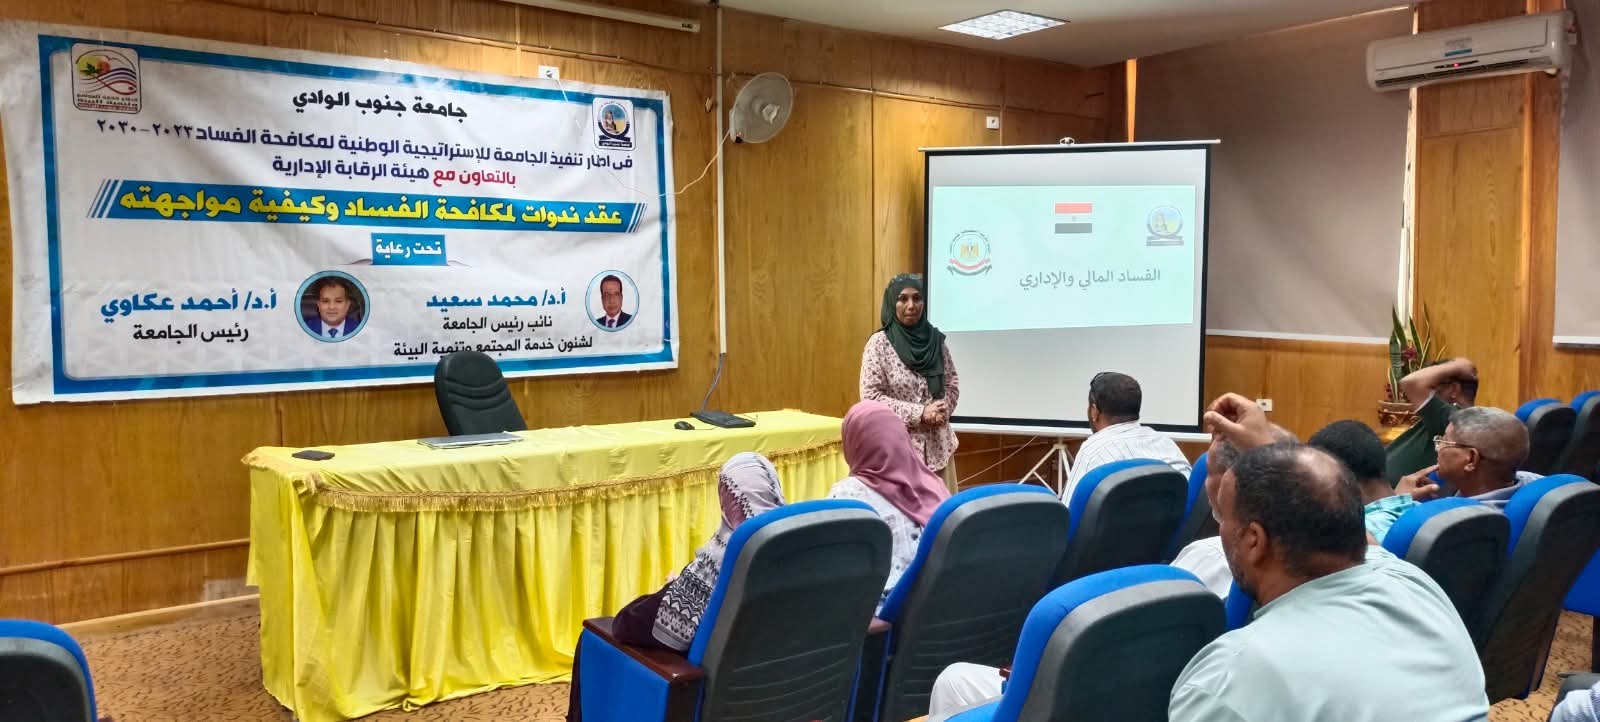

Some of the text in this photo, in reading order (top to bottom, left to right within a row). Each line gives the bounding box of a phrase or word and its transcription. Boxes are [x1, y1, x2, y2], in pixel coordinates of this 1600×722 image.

[293, 90, 467, 123] جامعة جنوب الوادي
[196, 126, 256, 144] الفساد
[260, 129, 334, 149] لمكافحة
[338, 135, 399, 156] الوطنية
[494, 148, 547, 166] الجامعة
[550, 152, 583, 168] تنفيذ
[273, 156, 515, 188] بالتعاون مع هيئة الرقابة الإدارية
[119, 184, 623, 228] عقد ندوات لمكافحة الفساد وكيفية مواجهته
[376, 239, 442, 258] تحت رعاية
[1019, 268, 1160, 291] الفساد المالي والإداري
[101, 292, 175, 323] عكاوي
[181, 288, 238, 311] أحمد
[425, 293, 482, 313] سعيد
[487, 292, 538, 309] محمد
[133, 324, 248, 344] رئيس الجامعة
[443, 316, 552, 333] نائب رئيس الجامعة
[394, 342, 427, 360] البيئة
[525, 338, 554, 350] خدمة
[558, 336, 592, 352] لشئون
